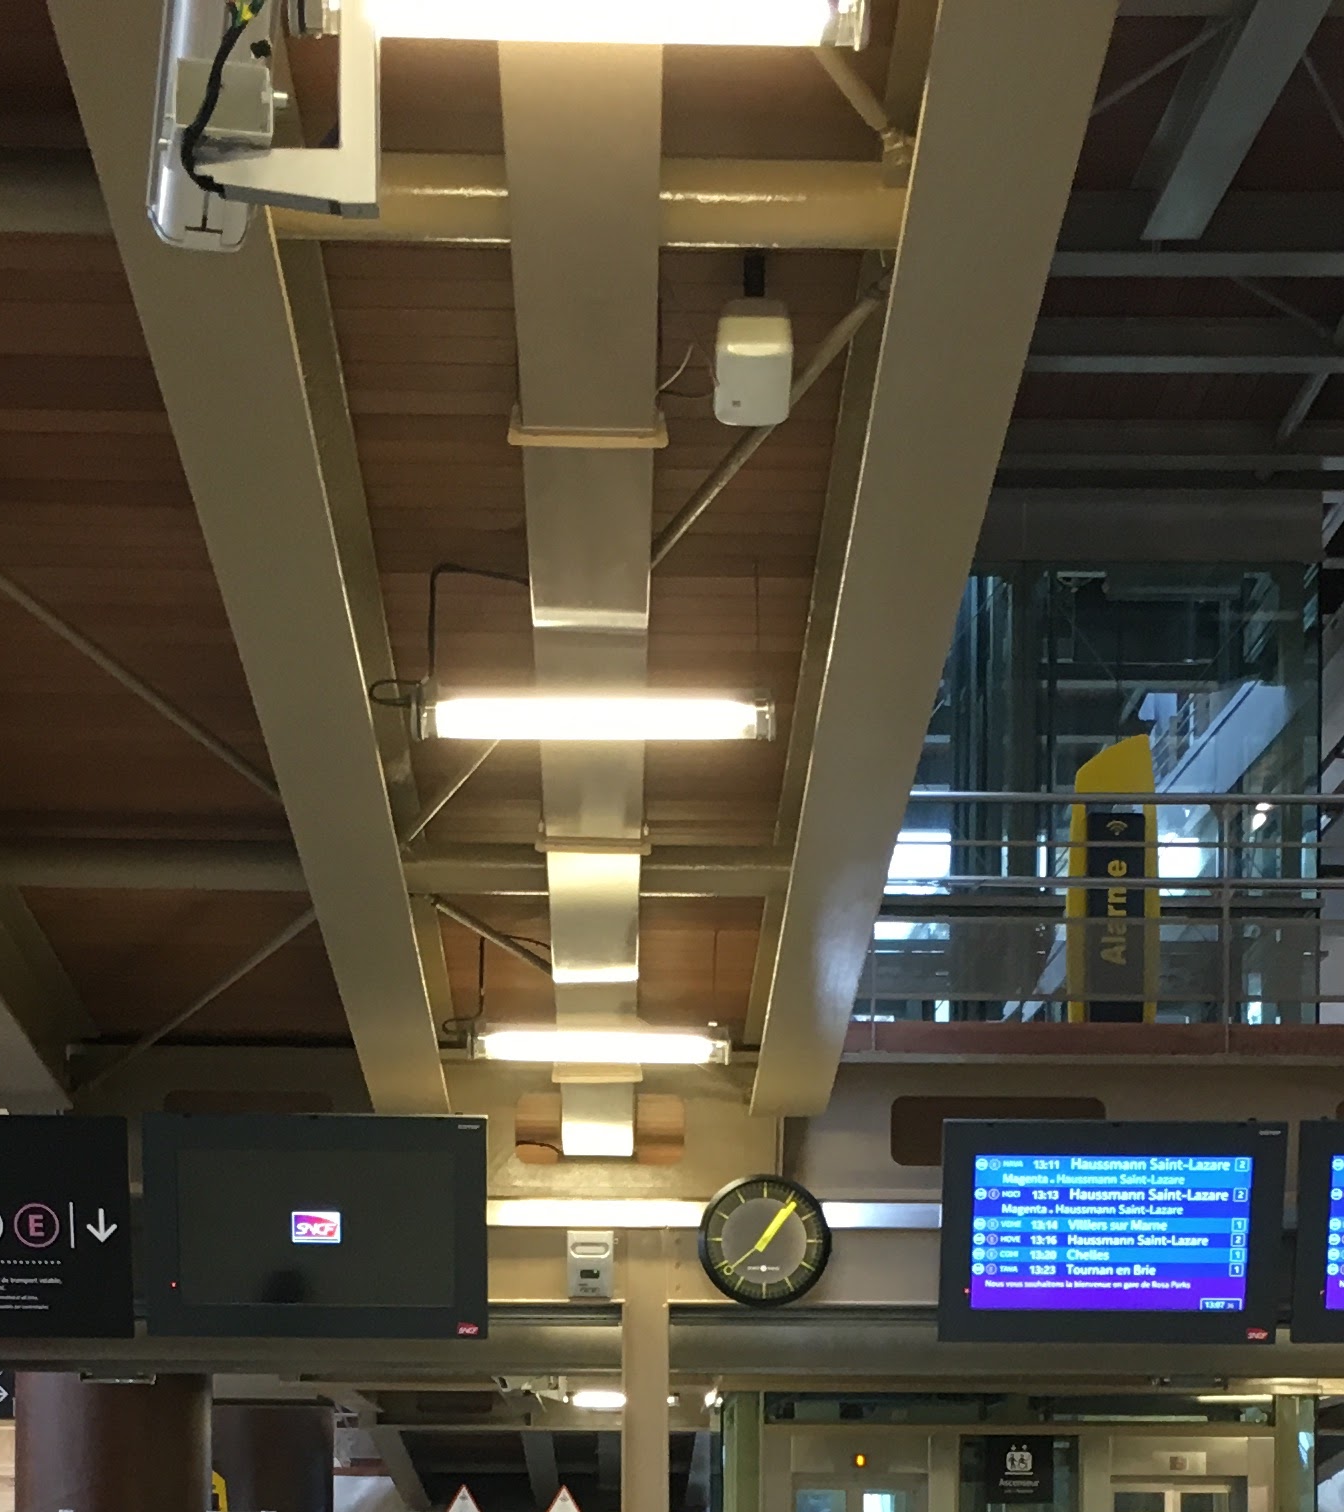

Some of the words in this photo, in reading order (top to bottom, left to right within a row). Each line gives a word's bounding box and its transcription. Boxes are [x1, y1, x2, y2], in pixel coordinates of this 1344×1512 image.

[1100, 860, 1127, 966] Alarme
[1033, 1160, 1060, 1170] 13:11
[1071, 1158, 1146, 1171] Haussmann
[1150, 1158, 1230, 1171] Saint-Lazare
[1003, 1174, 1048, 1186] Magenta
[1056, 1174, 1117, 1184] Haussmann
[1120, 1174, 1185, 1185] Saint-Lazare
[1032, 1190, 1059, 1200] 13:13
[1069, 1188, 1145, 1201] Haussmann
[1149, 1188, 1229, 1201] Saint-Lazare
[1002, 1204, 1047, 1216] Magenta
[1056, 1204, 1116, 1215] Haussmann
[1118, 1204, 1184, 1215] Saint-Lazare
[28, 1214, 45, 1237] E
[295, 1222, 336, 1235] SNCF
[1068, 1219, 1110, 1231] Villiers
[1113, 1221, 1129, 1231] sur
[1131, 1220, 1168, 1231] Marne
[1068, 1235, 1134, 1246] Haussmann
[1137, 1235, 1209, 1246] Saint-Lazare
[1066, 1249, 1110, 1261] Chelles
[1029, 1265, 1056, 1275] 13:23
[1066, 1264, 1113, 1276] Tournan
[1116, 1267, 1131, 1276] en
[1134, 1265, 1156, 1276] Brie
[985, 1280, 1005, 1288] Nous
[1152, 1280, 1169, 1289] Rosa
[1170, 1280, 1191, 1289] Parks
